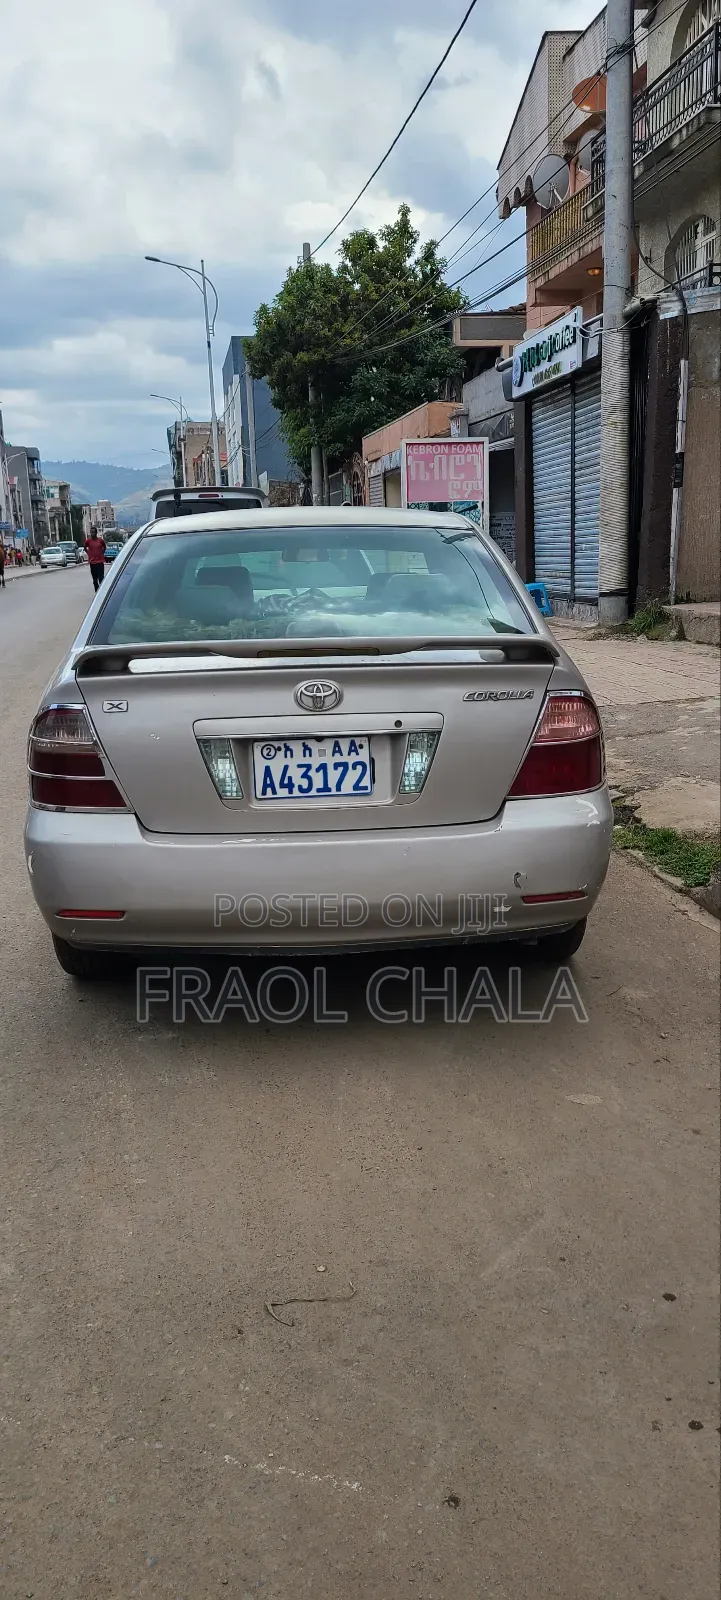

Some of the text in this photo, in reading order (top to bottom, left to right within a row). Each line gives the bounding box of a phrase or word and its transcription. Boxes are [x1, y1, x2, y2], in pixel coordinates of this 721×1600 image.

[406, 443, 483, 455] KEBRON FOAM
[463, 688, 535, 702] COROLLA
[331, 739, 360, 757] AA
[261, 761, 369, 796] A43172
